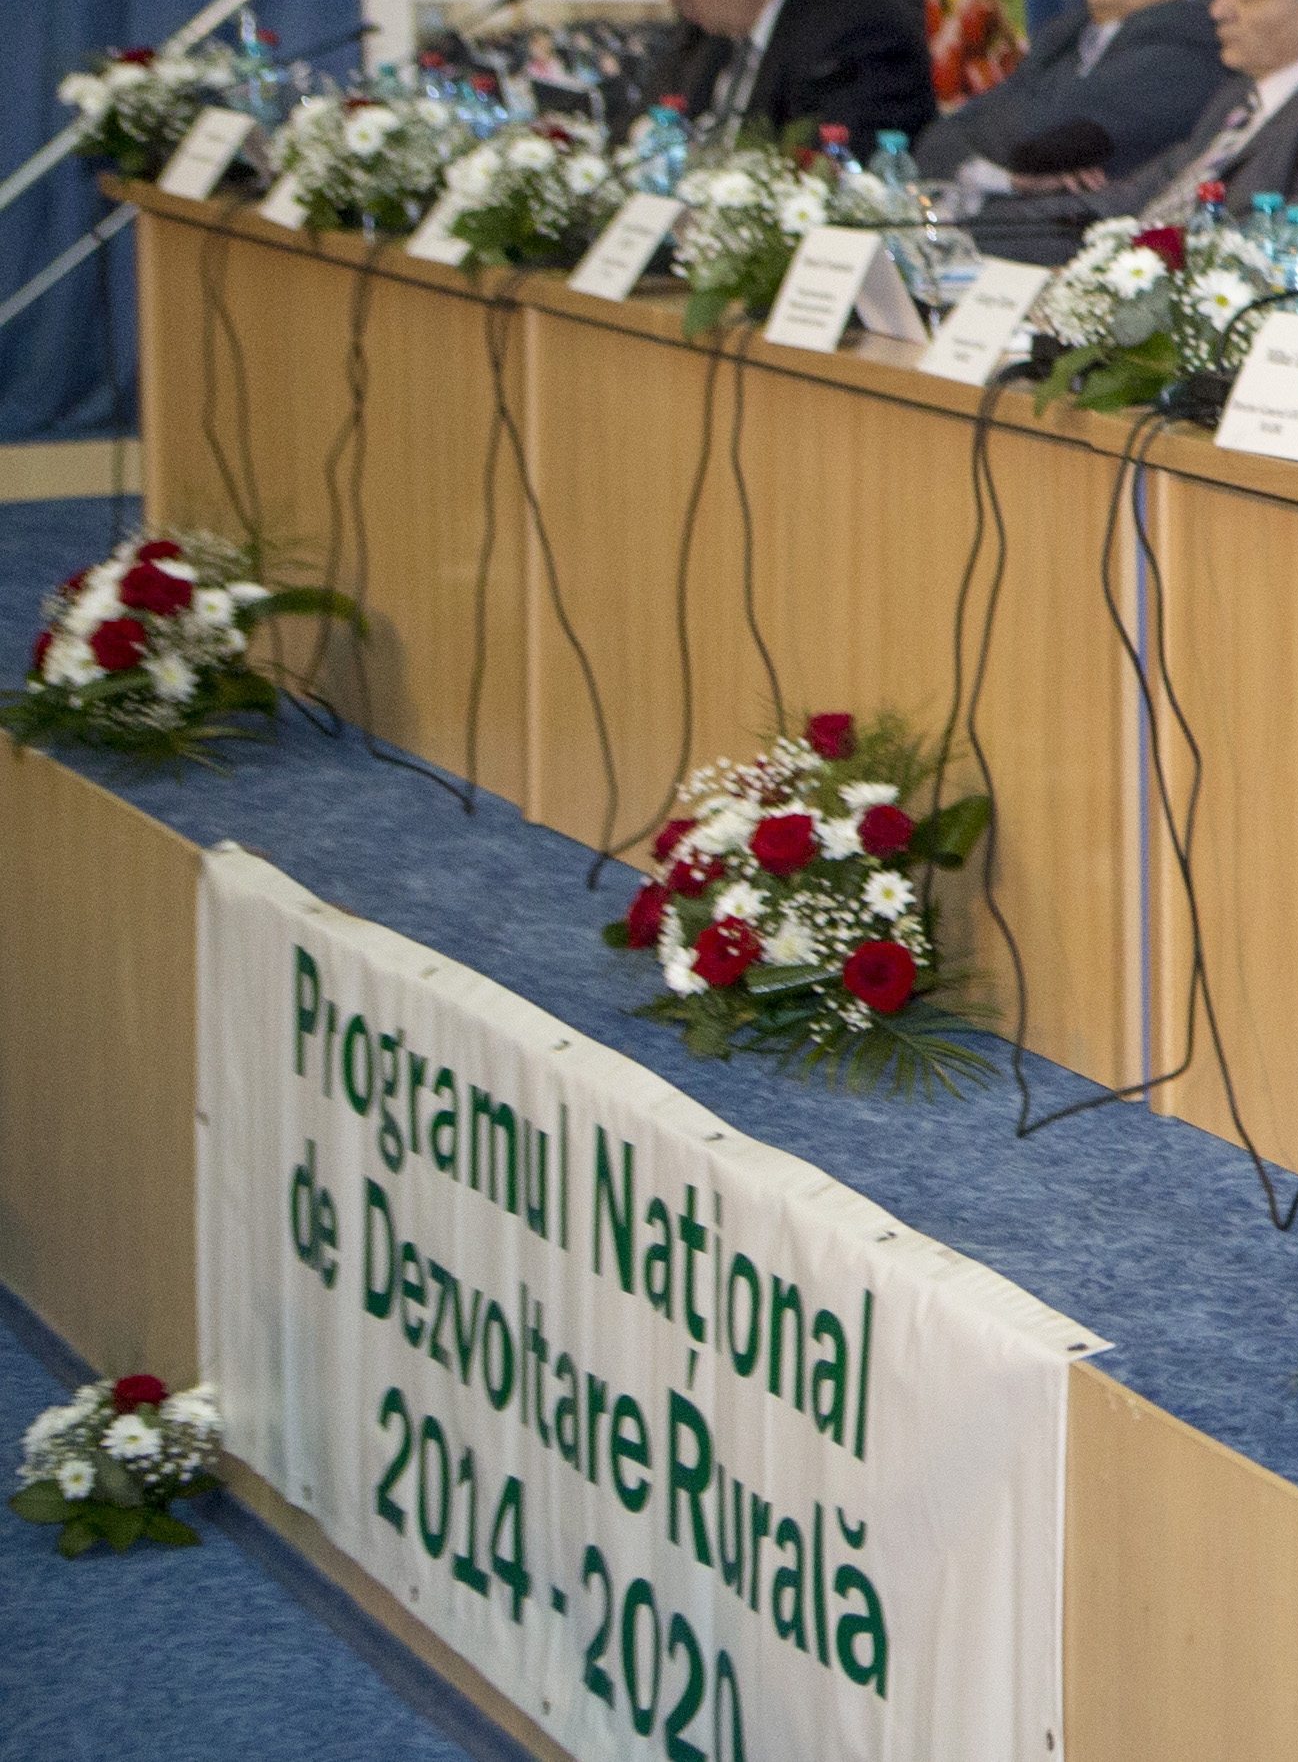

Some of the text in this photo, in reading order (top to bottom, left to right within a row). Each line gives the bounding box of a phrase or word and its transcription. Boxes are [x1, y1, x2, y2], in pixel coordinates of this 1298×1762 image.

[289, 1138, 890, 1702] de Dezvoltare Rurală
[293, 944, 877, 1463] Programul Național
[374, 1385, 534, 1626] 2014
